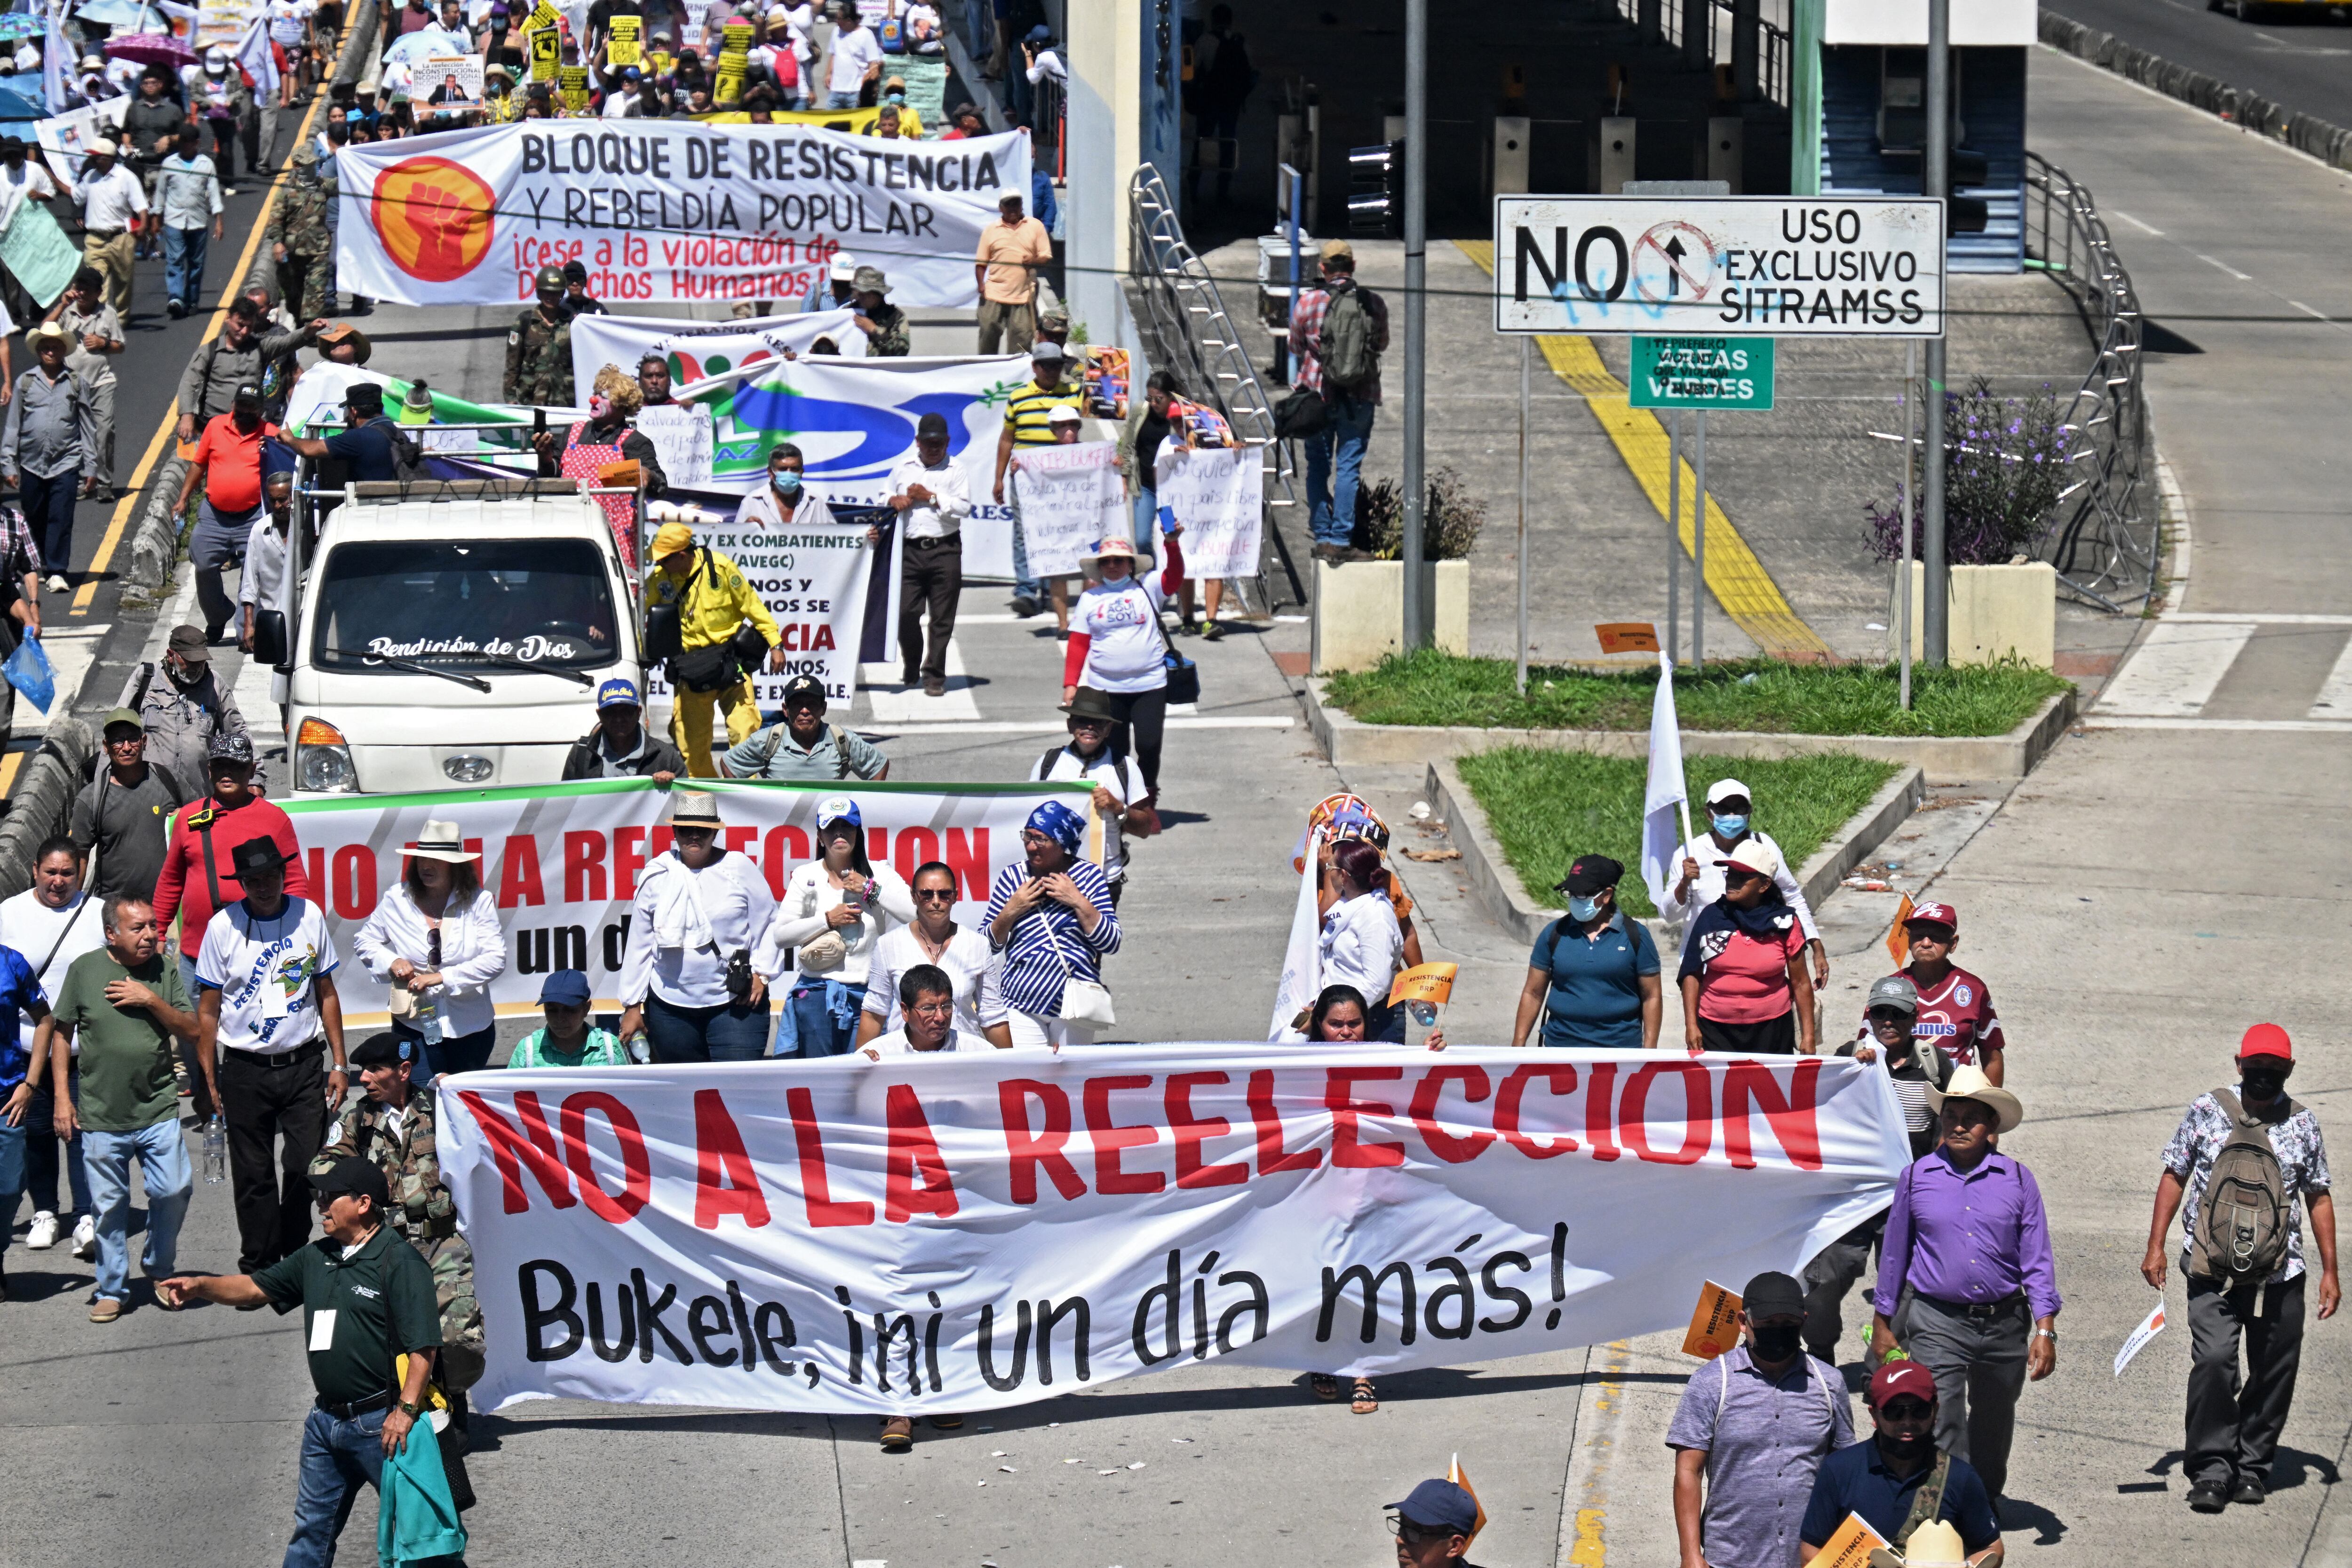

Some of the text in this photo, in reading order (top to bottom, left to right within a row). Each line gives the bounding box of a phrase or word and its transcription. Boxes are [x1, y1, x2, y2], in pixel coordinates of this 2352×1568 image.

[522, 132, 1000, 191] BLOQUE DE RESISTENCIA
[526, 186, 940, 238] Y REBELDÍA POPULAR
[1781, 208, 1861, 244] USO
[513, 230, 841, 270] ¡Cese a la violación de
[1515, 224, 1629, 302] NO
[1725, 249, 1917, 282] EXCLUSIVO
[518, 267, 652, 301] Dchos
[1718, 287, 1923, 325] SITRAMSS
[1648, 375, 1754, 399] VERDES
[703, 534, 863, 549] Y EX COMBATIENTES
[731, 553, 795, 571] (AVEGC)
[801, 579, 812, 592] Y
[807, 599, 830, 612] SE
[484, 637, 514, 656] de
[516, 635, 576, 662] Dios
[516, 924, 587, 975] un
[233, 937, 293, 1011] RESISTENCIA
[1408, 974, 1452, 984] RESISTENCIA
[458, 1089, 651, 1224] NO
[694, 1088, 771, 1230] A
[786, 1082, 959, 1228] LA
[518, 1221, 1567, 1396] Bukele, ¡ni un día más!
[1706, 1290, 1727, 1335] RESISTENCIA
[1716, 1300, 1731, 1331] POPULAR
[1725, 1309, 1736, 1325] BRP
